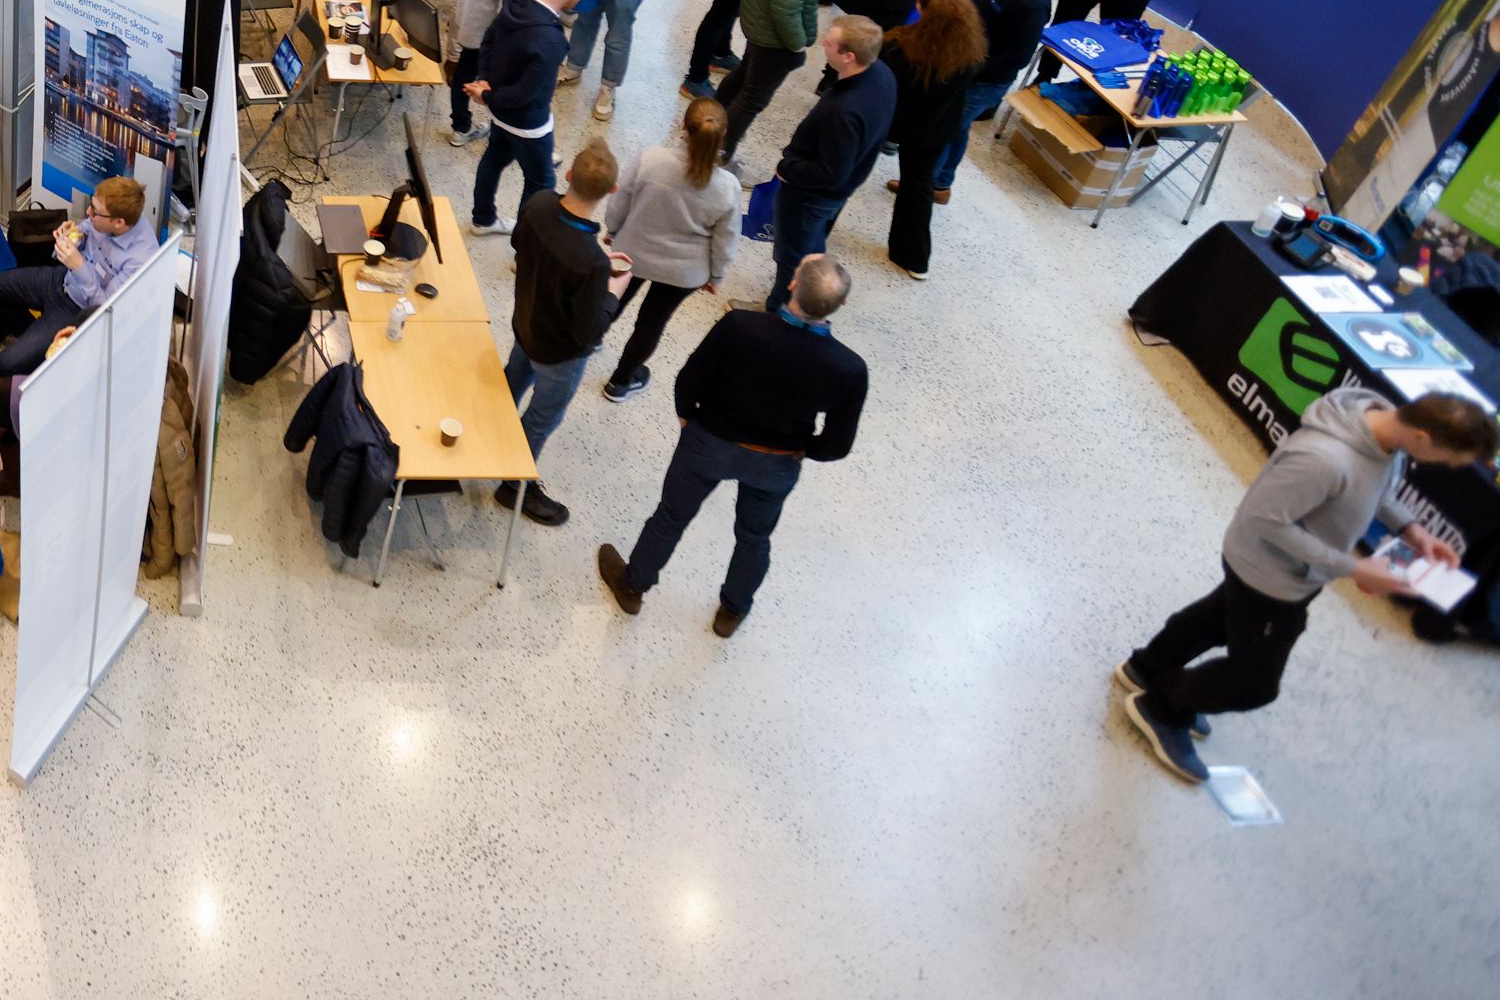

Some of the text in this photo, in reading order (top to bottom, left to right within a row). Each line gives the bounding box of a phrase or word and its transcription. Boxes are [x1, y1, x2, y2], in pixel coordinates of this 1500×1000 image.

[111, 22, 123, 35] fra
[125, 29, 149, 48] Eaton
[130, 19, 150, 36] skap
[152, 31, 164, 43] og
[1227, 372, 1290, 446] elma
